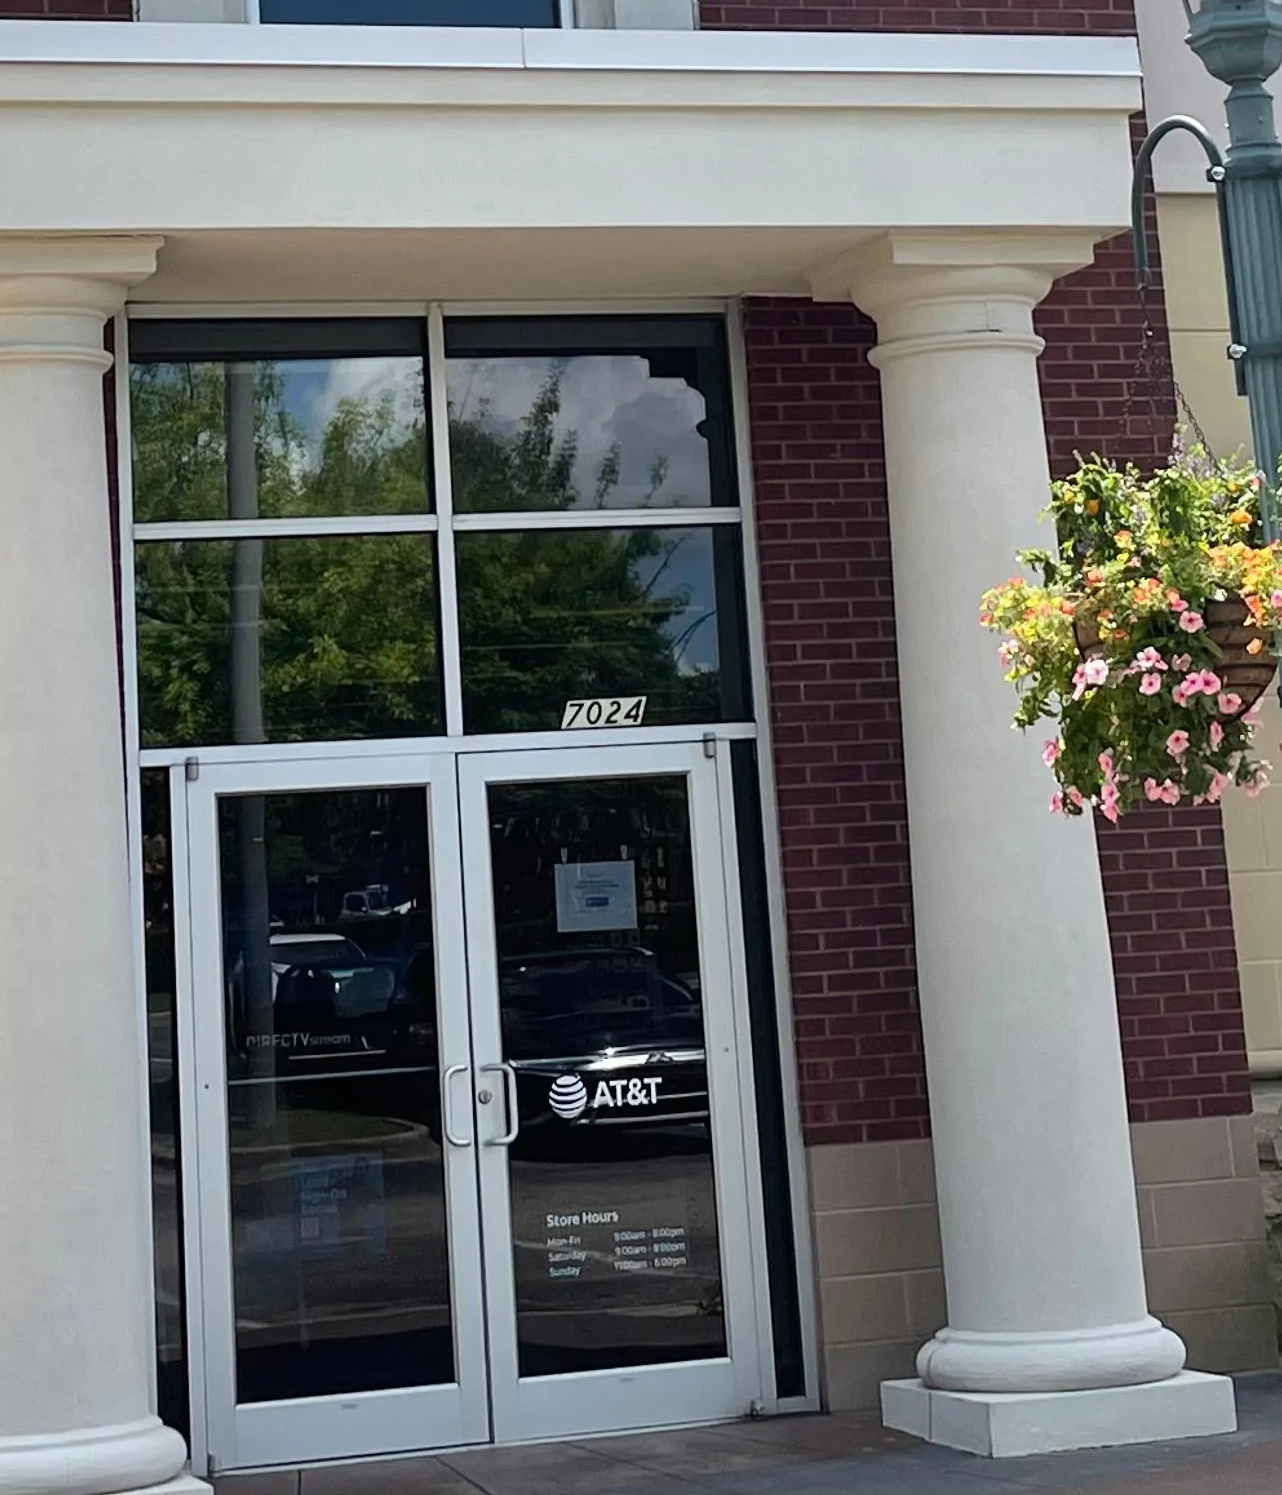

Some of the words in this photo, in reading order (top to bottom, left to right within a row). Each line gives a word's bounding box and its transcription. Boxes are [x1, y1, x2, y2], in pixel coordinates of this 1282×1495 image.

[566, 698, 643, 727] 7024
[592, 1076, 663, 1109] AT&T
[546, 1214, 580, 1228] Store
[582, 1211, 619, 1224] Hours
[546, 1235, 582, 1247] Mon-Fri
[547, 1249, 587, 1262] Saturday
[548, 1266, 581, 1277] Sunday
